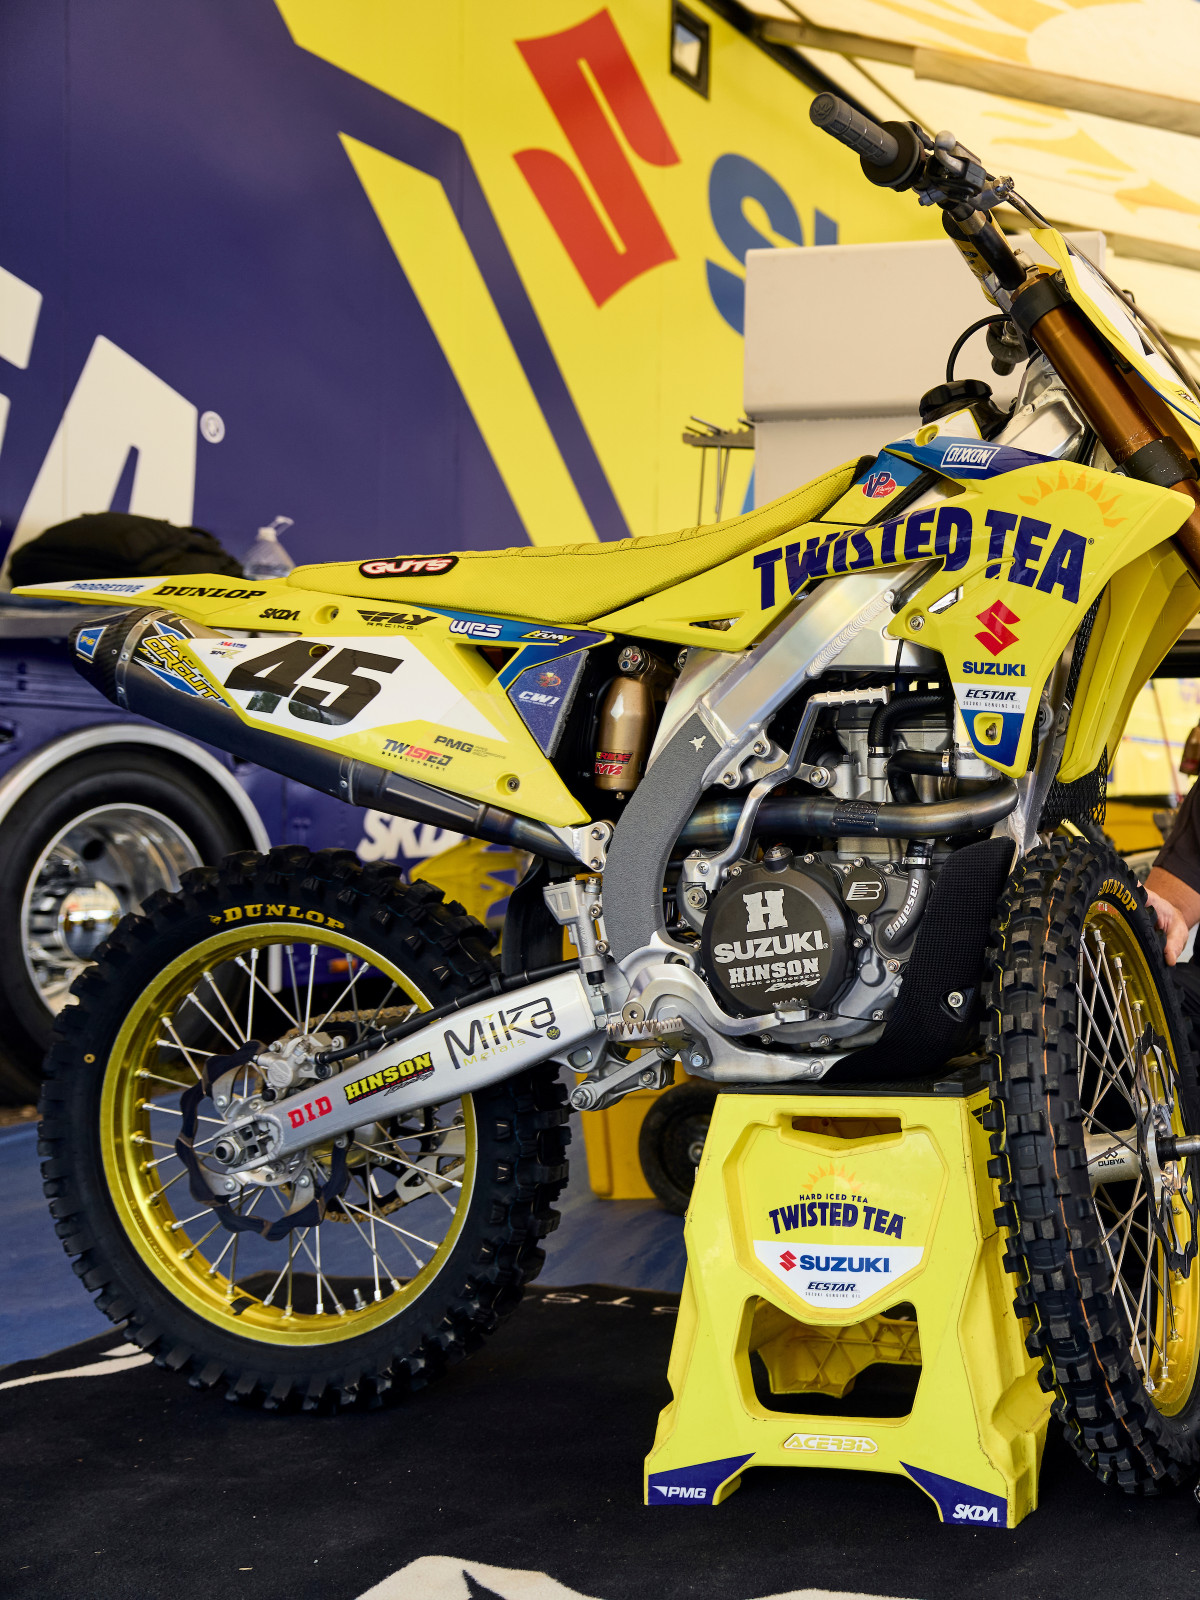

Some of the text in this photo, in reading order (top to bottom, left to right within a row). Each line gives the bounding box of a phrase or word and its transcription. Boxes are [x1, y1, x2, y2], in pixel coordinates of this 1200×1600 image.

[945, 446, 992, 464] DIXXON
[865, 471, 891, 498] VP
[361, 557, 453, 575] GUTS
[753, 507, 1089, 611] TWISTED TEA
[66, 582, 145, 594] PROGRESSIVE
[153, 585, 267, 600] DUNLOP
[357, 609, 438, 626] FLY
[366, 621, 418, 631] RACING
[450, 619, 503, 638] WPS
[143, 637, 222, 701] CIRCUIT
[962, 660, 1026, 677] SUZUKI
[223, 639, 405, 726] 45
[965, 688, 1016, 702] ECSTAR
[434, 735, 475, 753] PMG
[355, 806, 466, 862] SKD
[1102, 878, 1138, 911] DUNLOP
[223, 903, 346, 930] DUNLOP
[742, 888, 789, 933] H
[884, 878, 921, 941] Boyesen
[713, 929, 824, 964] SUZUKI
[728, 957, 820, 985] HINSON
[344, 1052, 433, 1101] HINSON
[287, 1095, 333, 1130] D.I.D
[799, 1193, 869, 1204] HARD ICED TEA
[768, 1202, 905, 1240] TWISTED TEA
[799, 1254, 891, 1273] SUZUKI
[807, 1281, 857, 1292] ECSTAR
[667, 1486, 707, 1500] PMG
